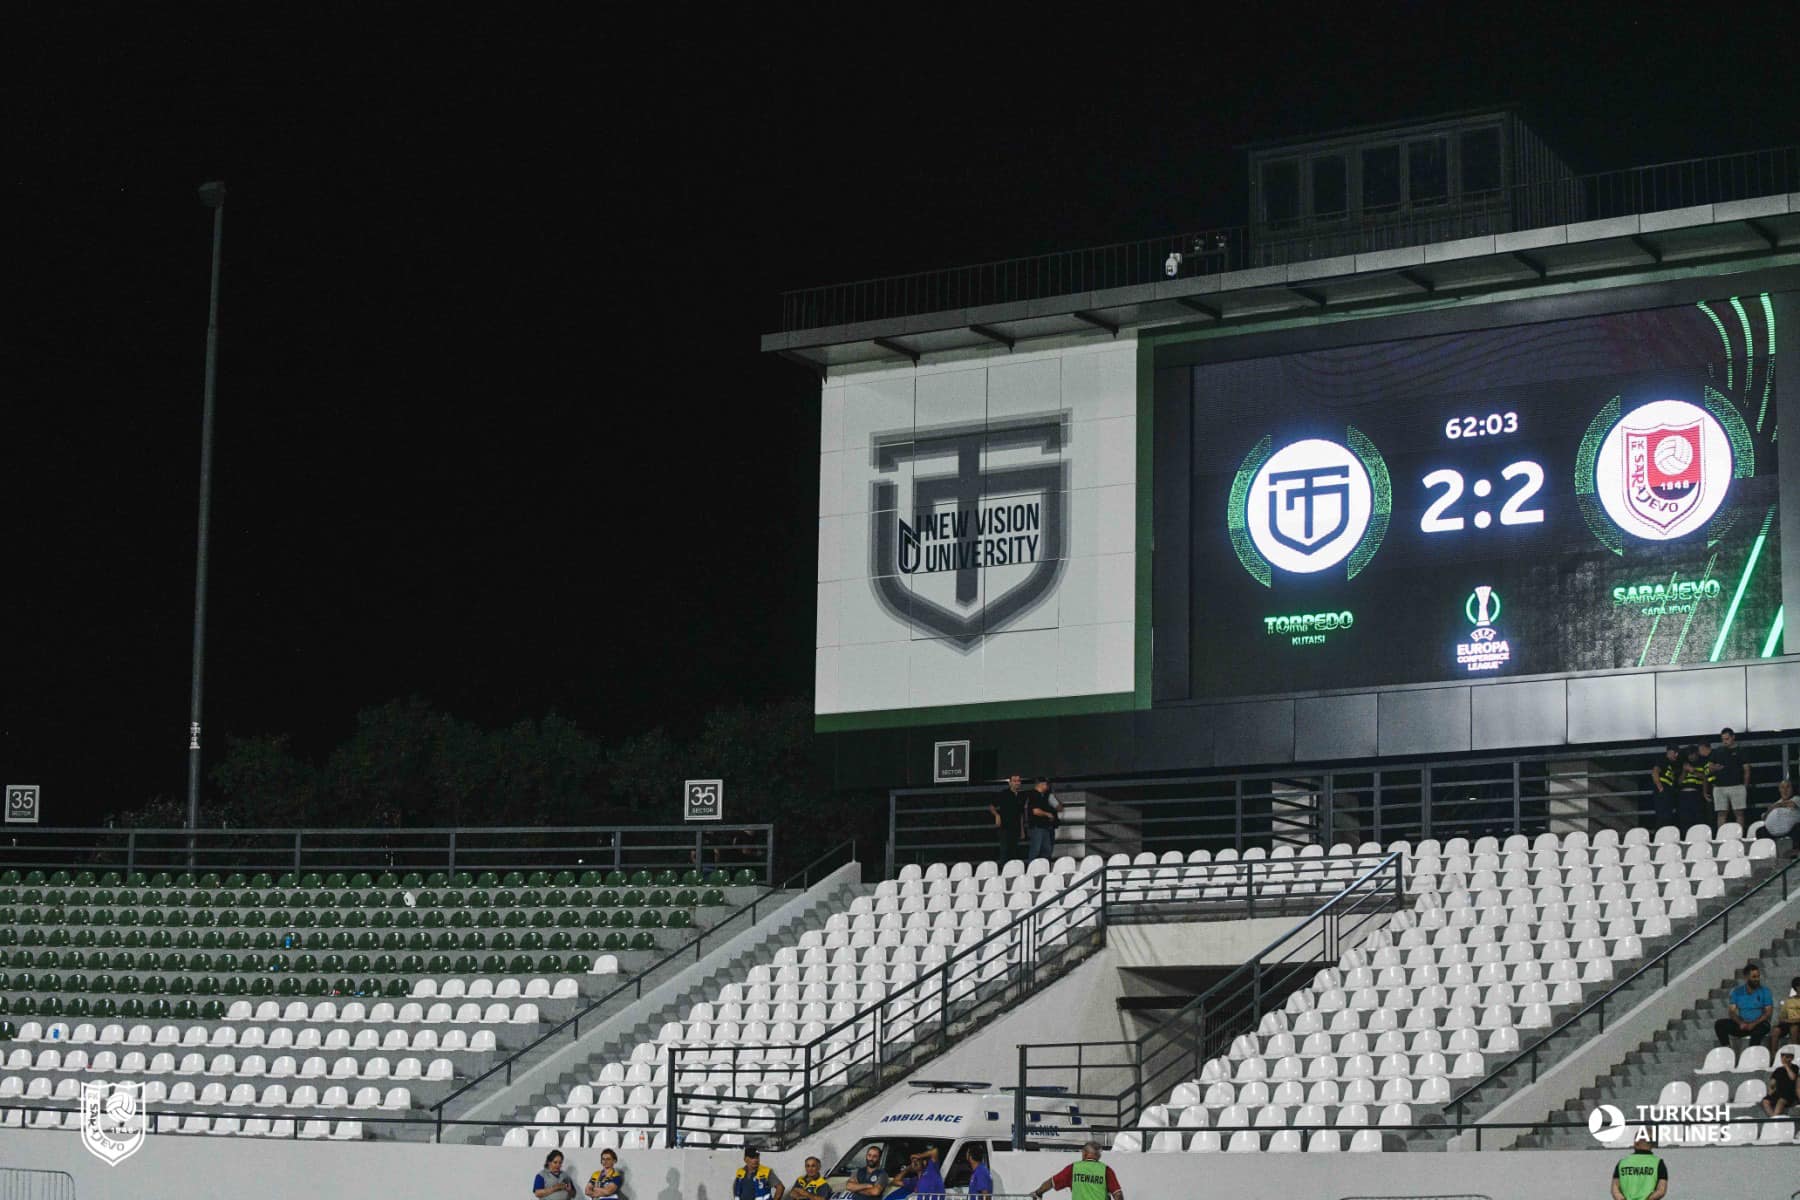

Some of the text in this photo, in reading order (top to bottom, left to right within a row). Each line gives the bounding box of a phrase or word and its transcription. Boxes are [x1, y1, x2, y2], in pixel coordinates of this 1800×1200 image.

[1445, 412, 1519, 439] 62:03
[1420, 460, 1545, 533] 2:2
[925, 502, 1040, 541] NEW VISION
[925, 534, 1040, 573] UNIVERSITY
[1613, 579, 1721, 606] SARAJEVO
[1263, 610, 1354, 635] TORPEDO
[1291, 634, 1326, 646] KUTAISI
[1456, 640, 1510, 656] EUROPA
[947, 747, 954, 768] 1
[11, 791, 34, 809] 35
[691, 786, 715, 806] 35
[880, 1113, 964, 1124] AMBULANCE
[1620, 1166, 1654, 1176] STEWARD
